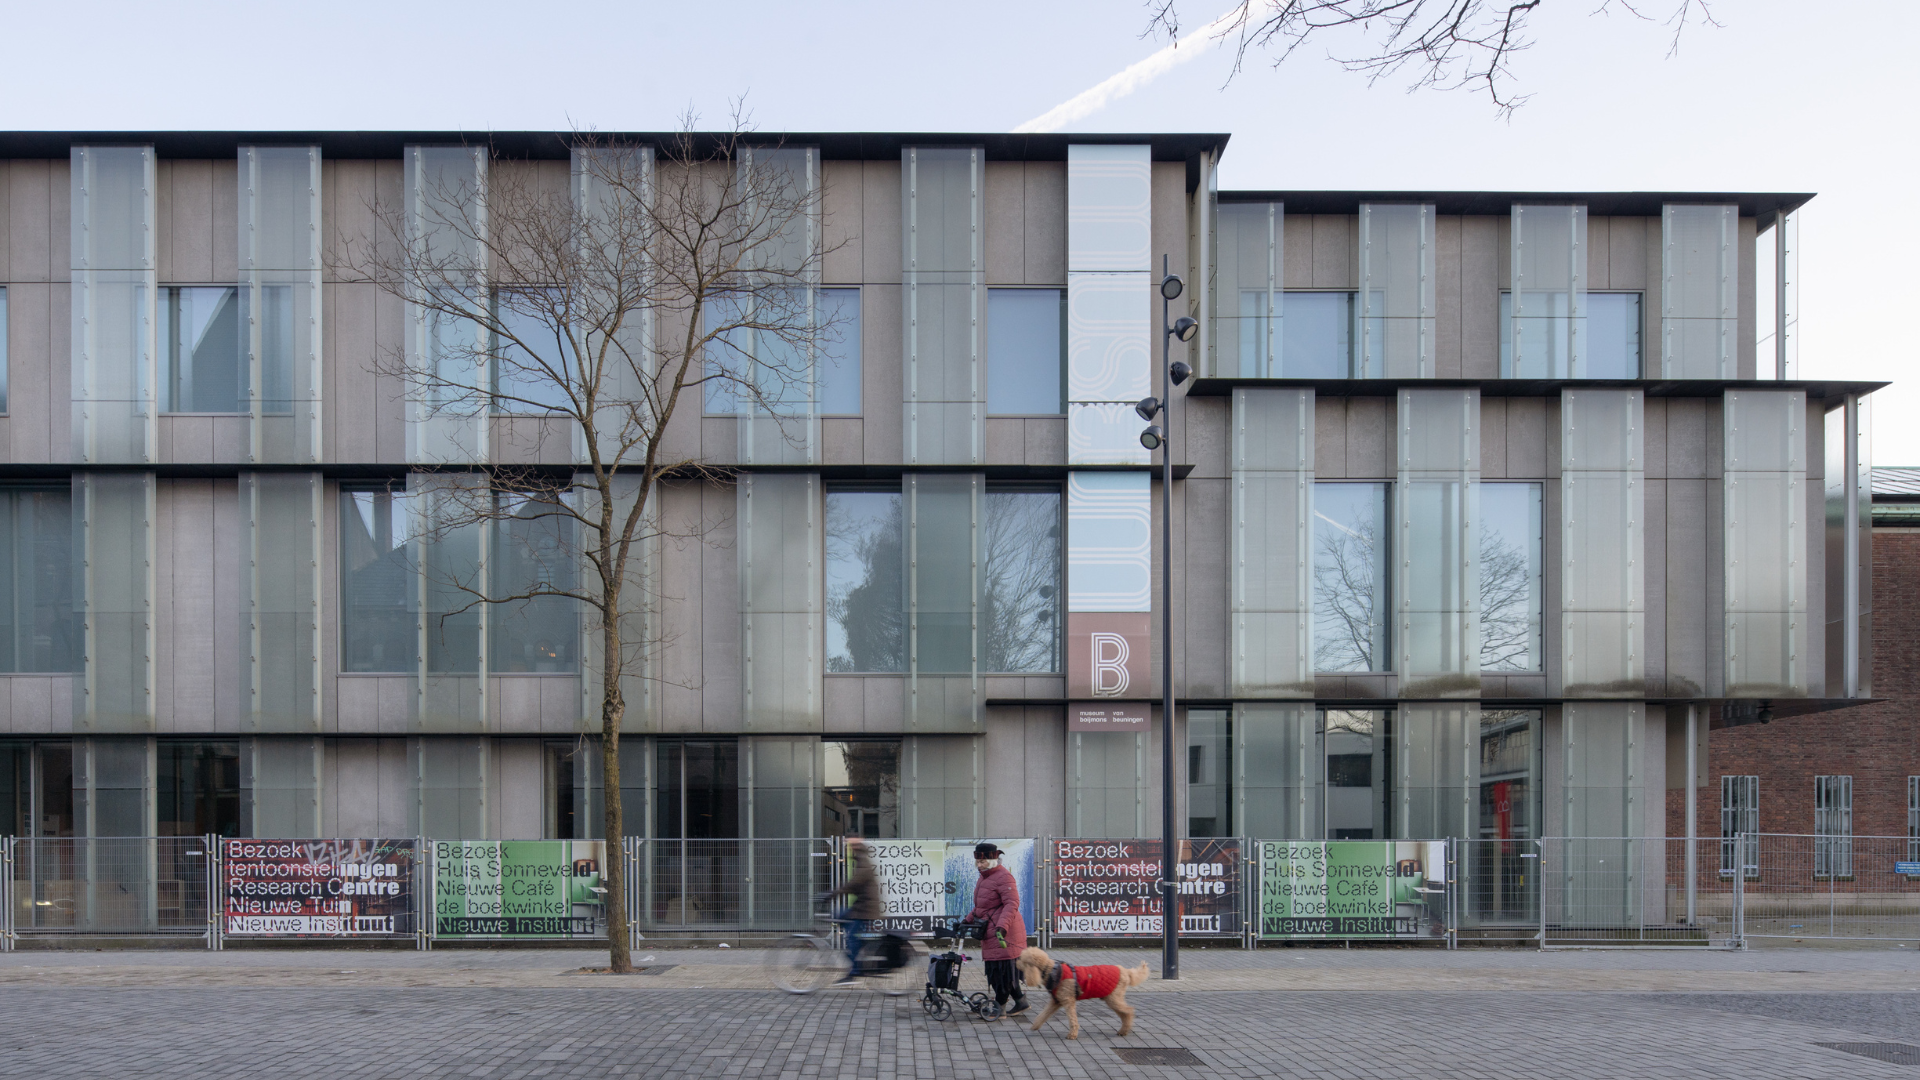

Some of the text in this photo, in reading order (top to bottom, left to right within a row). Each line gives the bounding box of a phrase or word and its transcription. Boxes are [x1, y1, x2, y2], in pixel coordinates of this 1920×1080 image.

[1091, 632, 1130, 698] B
[1112, 716, 1144, 724] beuningen
[229, 840, 302, 858] Bezoek
[437, 842, 509, 859] Bezoek
[855, 842, 923, 858] ezoek
[1058, 841, 1129, 859] Bezoek
[1263, 843, 1334, 860] Bezoek
[229, 860, 398, 879] tentoonstellingen
[437, 860, 591, 878] Huis Sonneveld
[857, 860, 931, 881] zingen
[1058, 859, 1224, 879] tentoonstelngen
[1263, 860, 1415, 878] Huis Sonneveld
[229, 877, 400, 895] Research Centre
[437, 879, 554, 896] Nieuwe Café
[860, 878, 957, 898] rkshops
[1059, 878, 1149, 895] Research
[1263, 879, 1379, 896] Nieuwe Café
[229, 896, 352, 913] Nieuwe Tuin
[436, 898, 569, 915] de boekwinkel
[1058, 896, 1129, 913] Nieuwe
[1263, 898, 1393, 915] de boekwinkel
[230, 916, 393, 931] Nieuwe Instituut
[437, 917, 594, 932] Nieuwe Instituut
[858, 916, 924, 931] ieuwe
[1059, 915, 1219, 931] Nieuwe Instuut
[1263, 917, 1417, 932] Nieuwe Instituut
